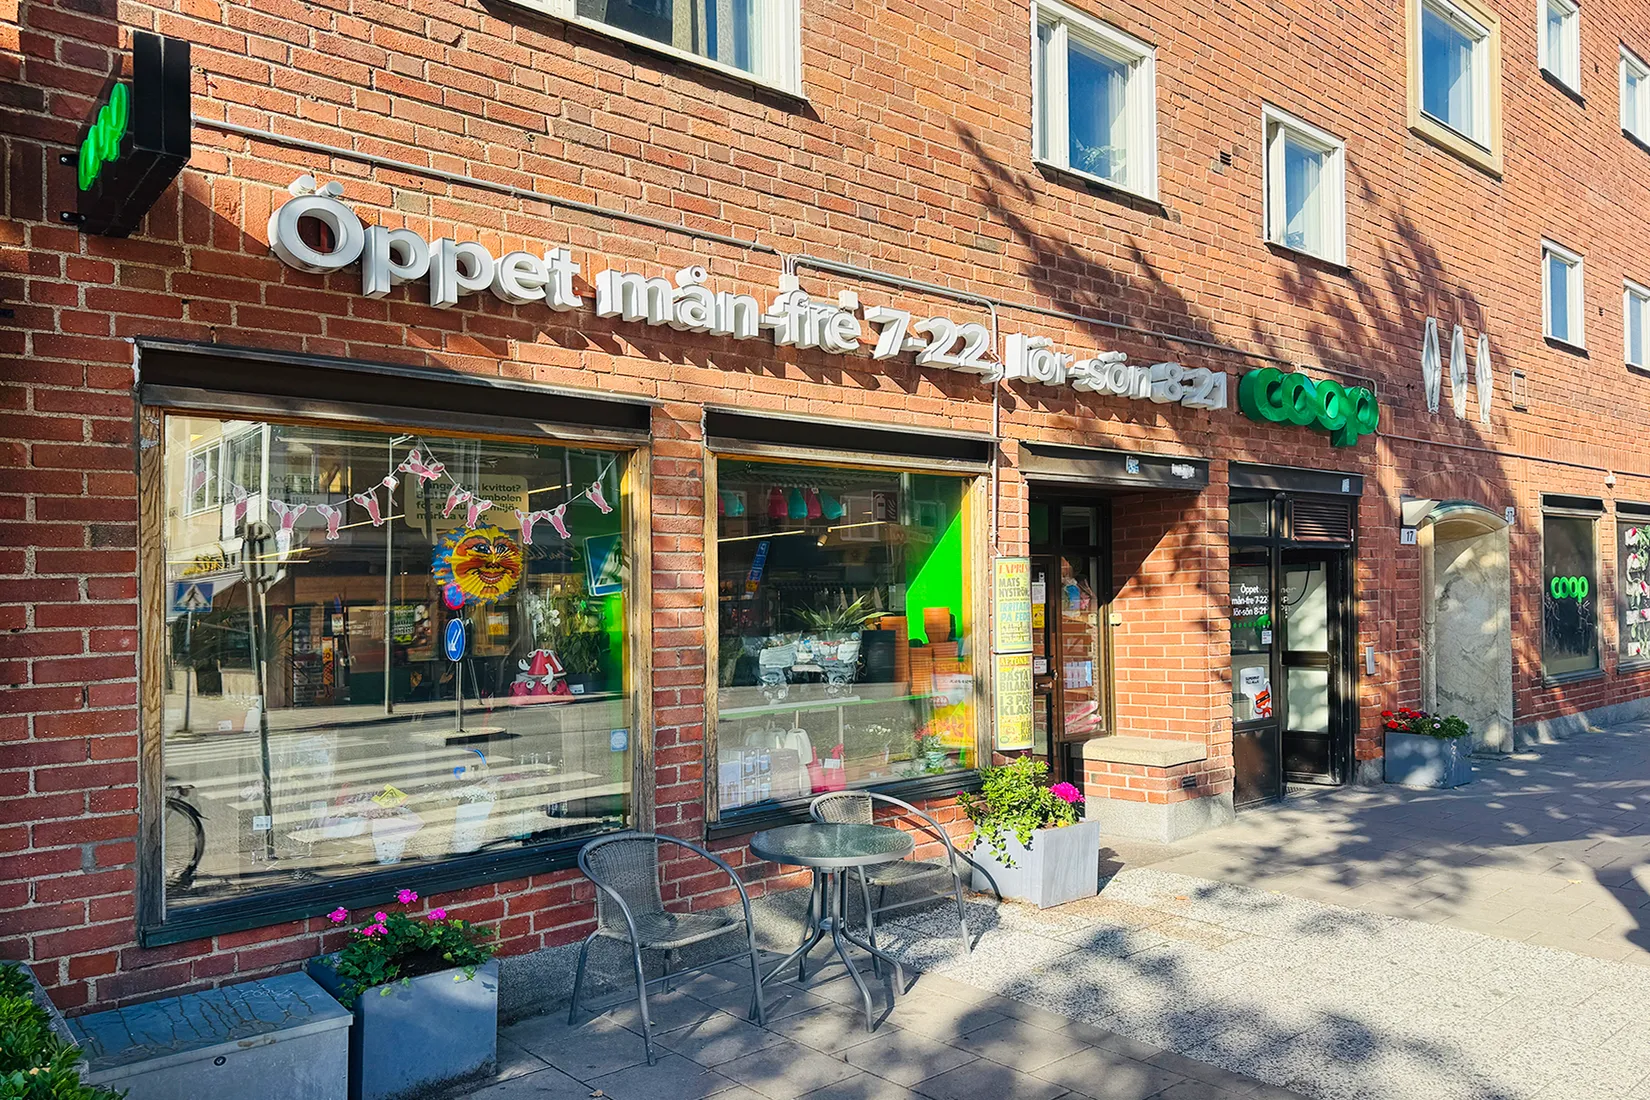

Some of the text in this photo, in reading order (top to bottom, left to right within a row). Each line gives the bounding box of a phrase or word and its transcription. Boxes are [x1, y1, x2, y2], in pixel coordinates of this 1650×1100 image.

[267, 175, 583, 312] Öppet
[596, 264, 861, 354] mån-fre
[1005, 332, 1152, 399] lör-sön
[1238, 367, 1380, 447] coop
[482, 483, 521, 492] kvittot?
[474, 494, 522, 502] ymbolen
[1406, 530, 1414, 542] 17
[1240, 583, 1260, 595] Öppet
[1551, 576, 1589, 603] coop
[1233, 607, 1253, 616] lör-sön
[1006, 695, 1014, 706] 3
